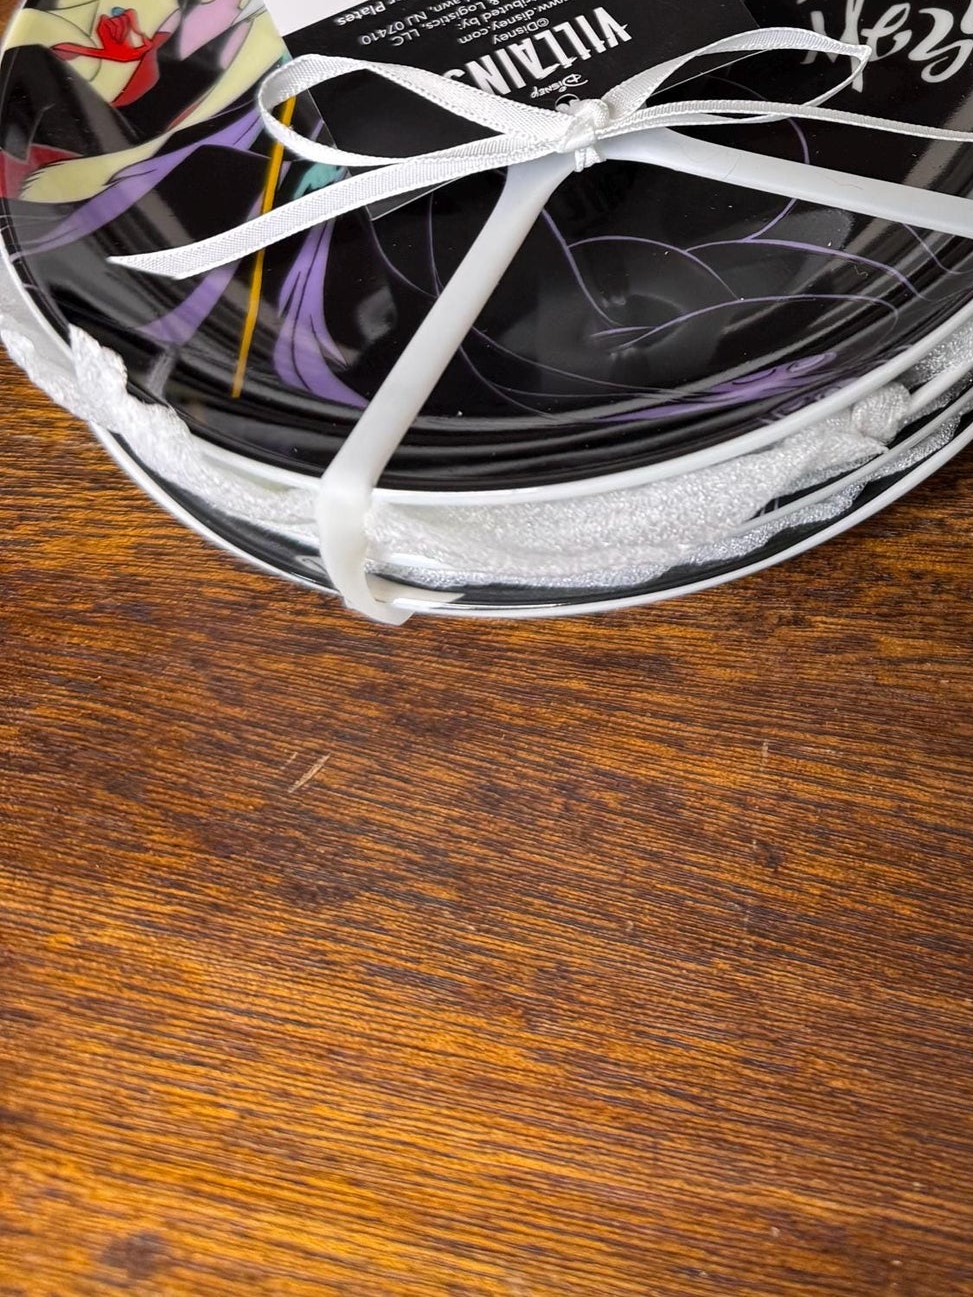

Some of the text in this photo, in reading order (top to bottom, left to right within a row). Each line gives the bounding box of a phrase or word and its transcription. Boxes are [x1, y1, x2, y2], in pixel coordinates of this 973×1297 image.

[335, 1, 386, 26] Plates
[407, 10, 427, 25] NJ
[421, 1, 486, 30] Logistics,
[457, 16, 480, 30] by:
[360, 21, 404, 45] 07410
[389, 28, 420, 46] LLC
[493, 17, 549, 44] ©Disney
[530, 74, 588, 98] Disney
